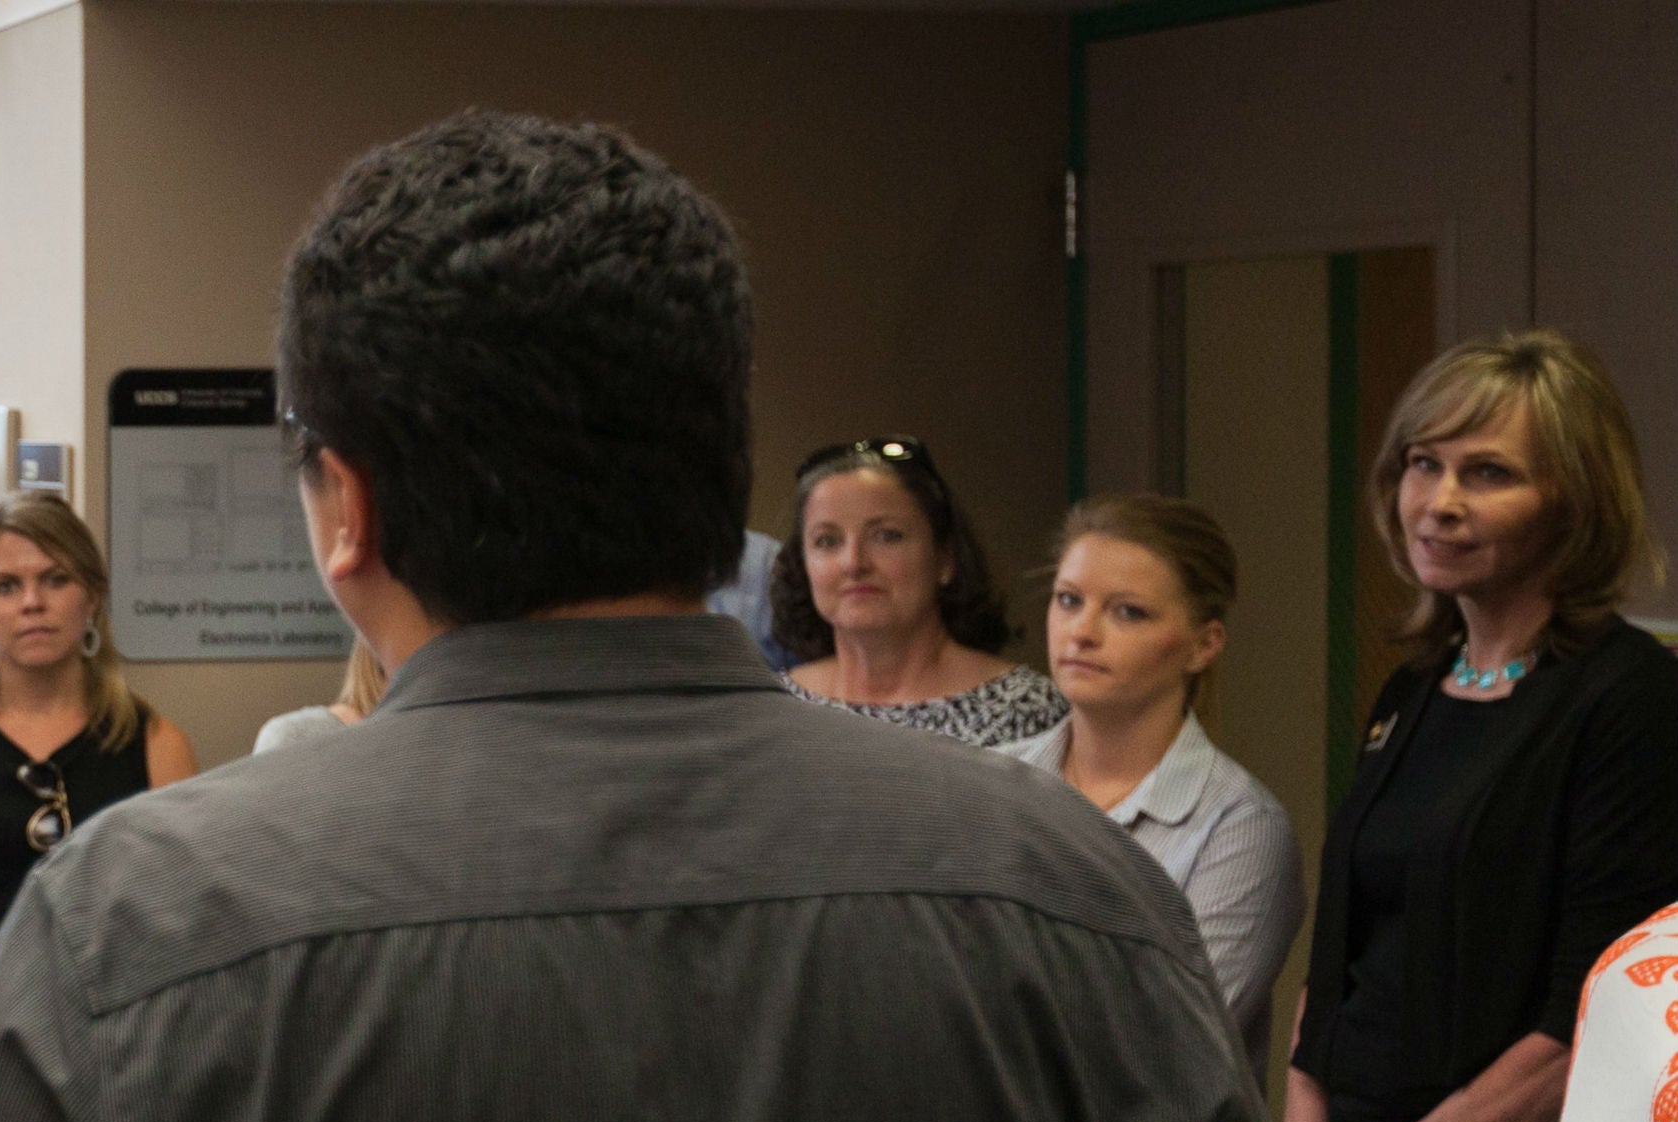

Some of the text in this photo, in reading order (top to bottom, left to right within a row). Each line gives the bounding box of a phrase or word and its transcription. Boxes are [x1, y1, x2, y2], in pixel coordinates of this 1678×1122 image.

[133, 600, 180, 619] College
[185, 600, 198, 615] of
[201, 600, 276, 618] Engineering
[281, 600, 304, 615] and
[199, 630, 344, 648] Electronics Laboratory
